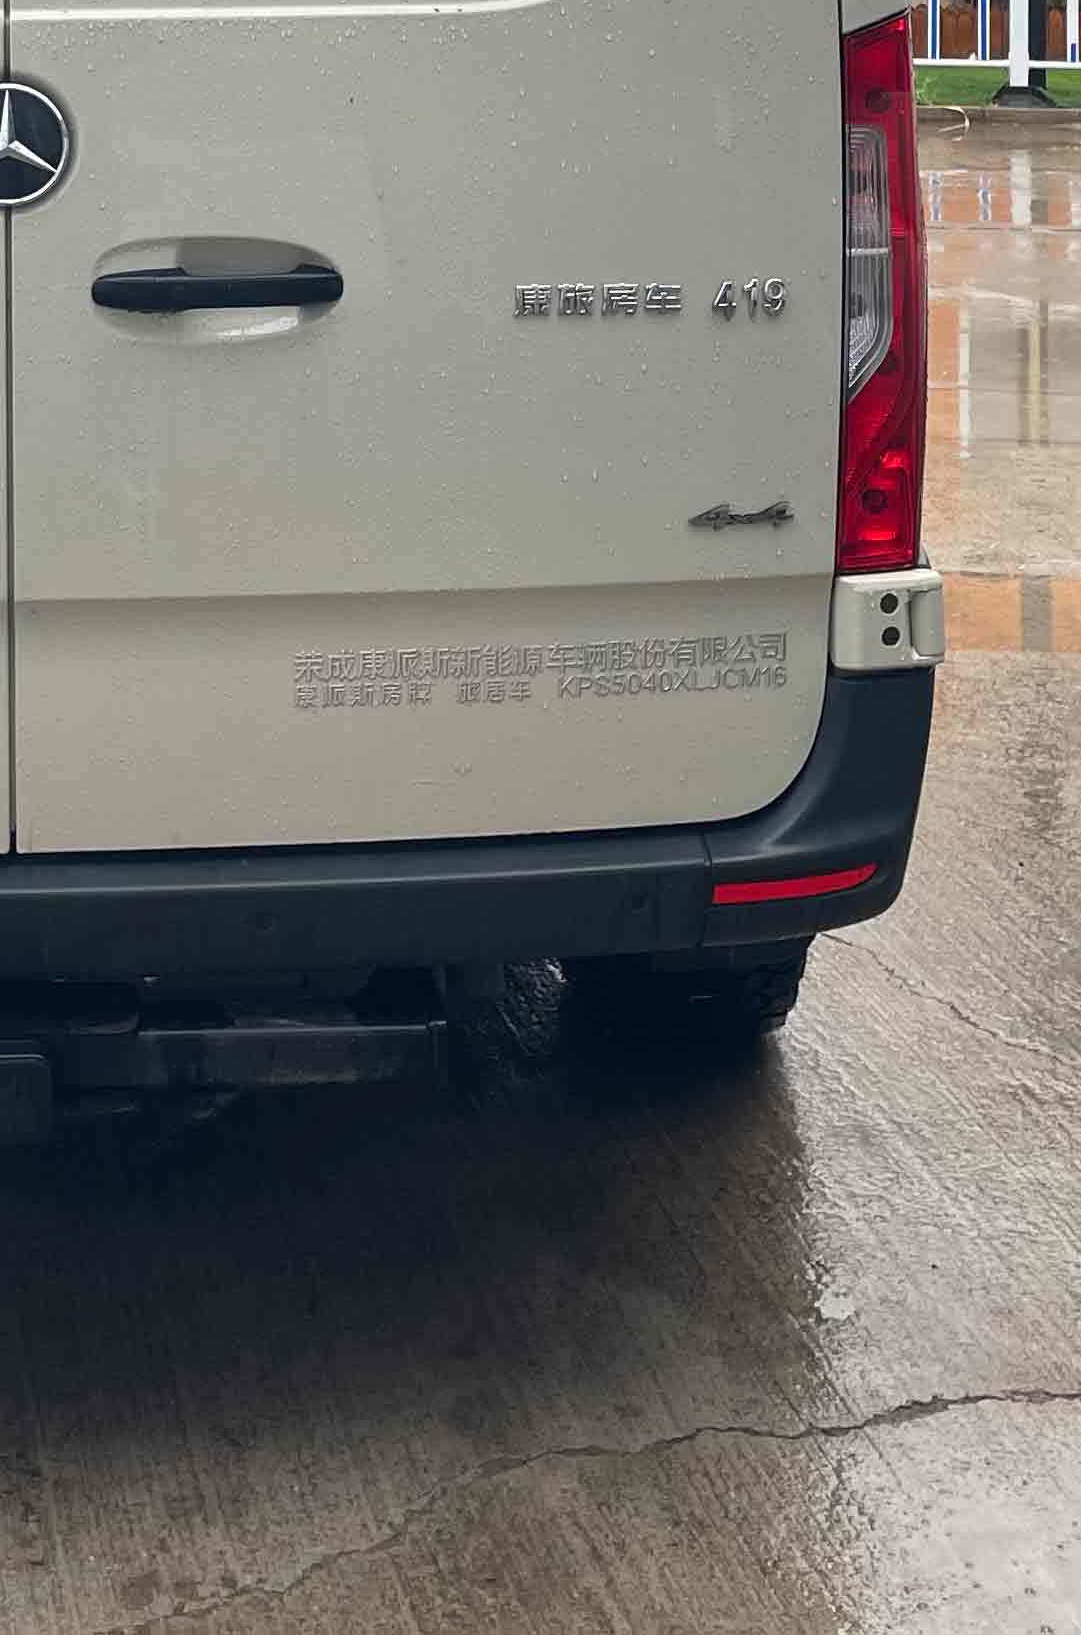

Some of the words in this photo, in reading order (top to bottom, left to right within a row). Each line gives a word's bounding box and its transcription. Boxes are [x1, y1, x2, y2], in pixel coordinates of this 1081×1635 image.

[712, 277, 788, 322] 419
[293, 631, 788, 684] 荣成康派斯新能源车辆股份有限公司
